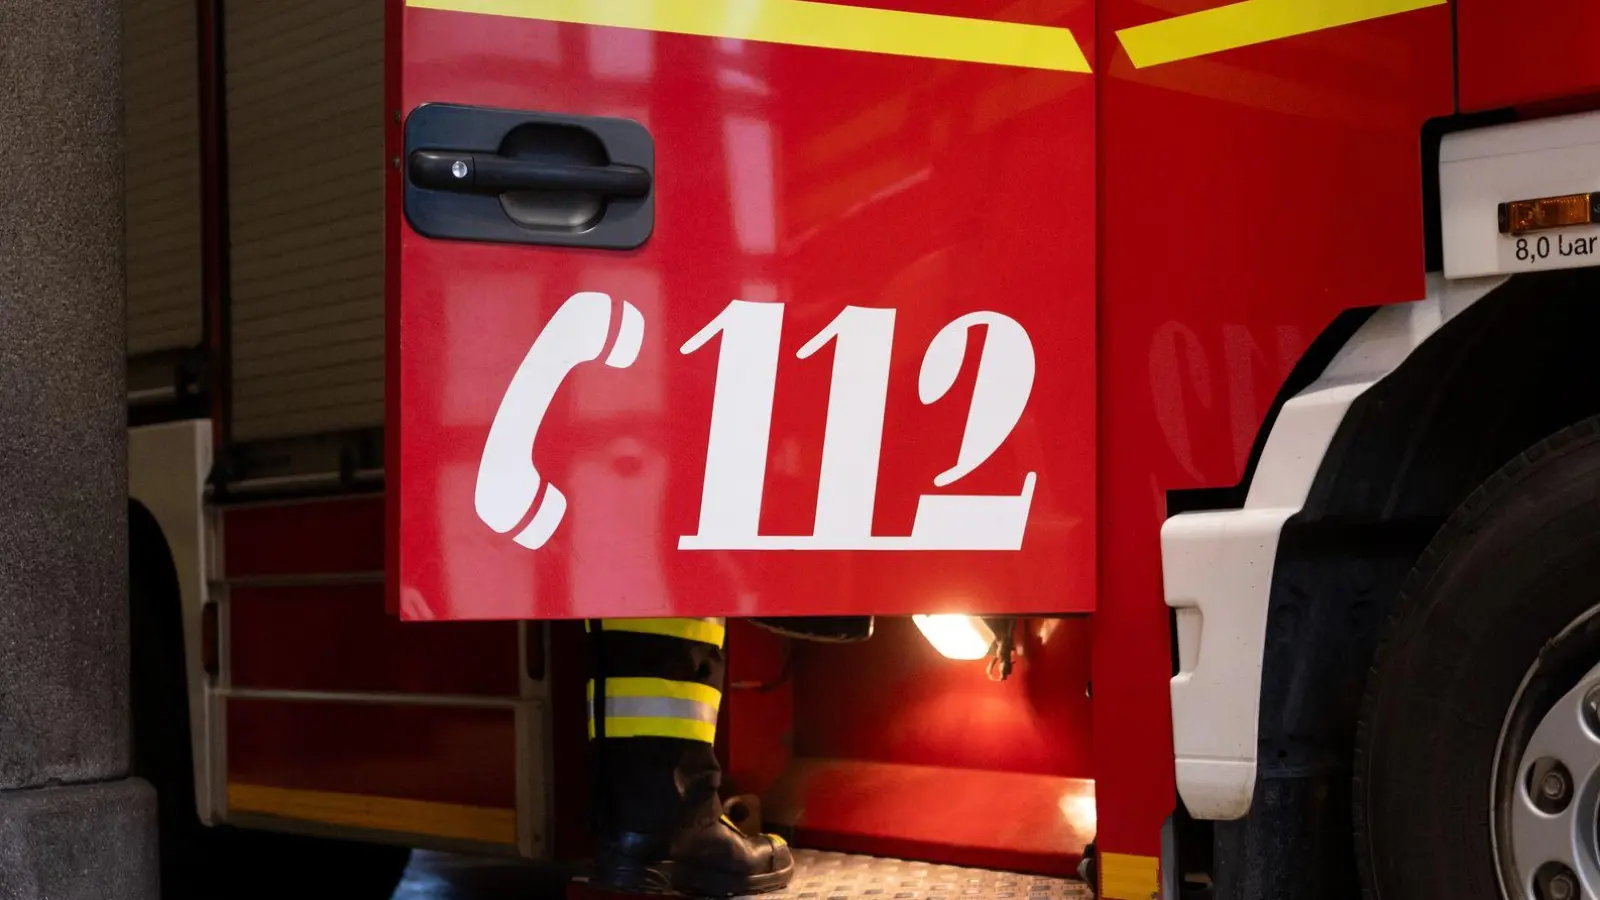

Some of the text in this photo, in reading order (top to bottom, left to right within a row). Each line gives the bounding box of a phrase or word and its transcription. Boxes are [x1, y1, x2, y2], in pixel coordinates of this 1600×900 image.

[1515, 234, 1598, 264] 8,0 bar
[677, 299, 1037, 551] 112
